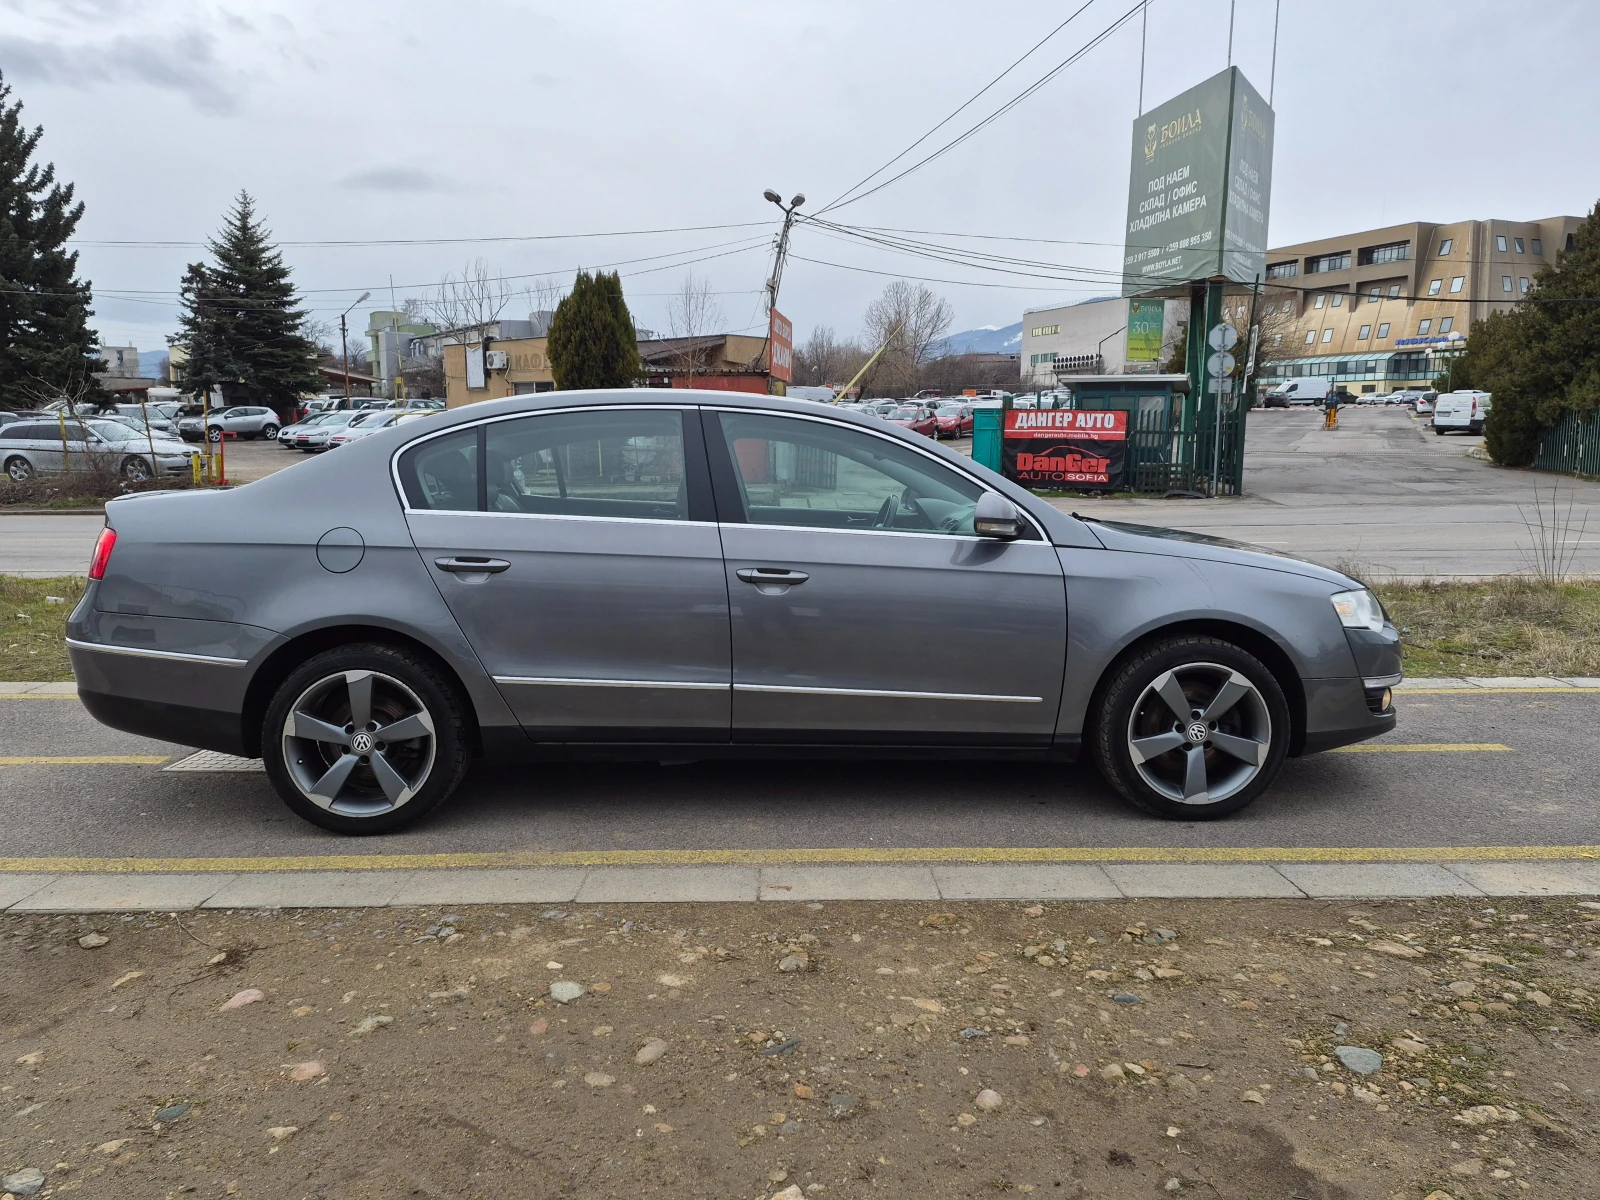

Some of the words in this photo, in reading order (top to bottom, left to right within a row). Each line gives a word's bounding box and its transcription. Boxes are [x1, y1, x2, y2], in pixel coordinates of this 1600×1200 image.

[1160, 108, 1202, 143] БОИЛА
[1148, 176, 1165, 194] ПОД
[1166, 164, 1190, 186] НАЕМ
[1139, 193, 1165, 214] СКЛАД
[1172, 180, 1198, 201] ОФИС
[1128, 208, 1171, 234] ХЛАДИЛНА
[1172, 194, 1207, 218] КАМЕРА
[1141, 255, 1182, 273] WWW.BOYLA.NET
[1132, 321, 1149, 334] 30
[1015, 412, 1073, 429] ДАНГЕР
[1075, 413, 1115, 428] АУТО
[1033, 432, 1098, 440] dangerauto.mobile.bg
[1017, 453, 1110, 473] DanGer
[1017, 471, 1064, 480] AUTO
[1067, 473, 1107, 481] SOFIA
